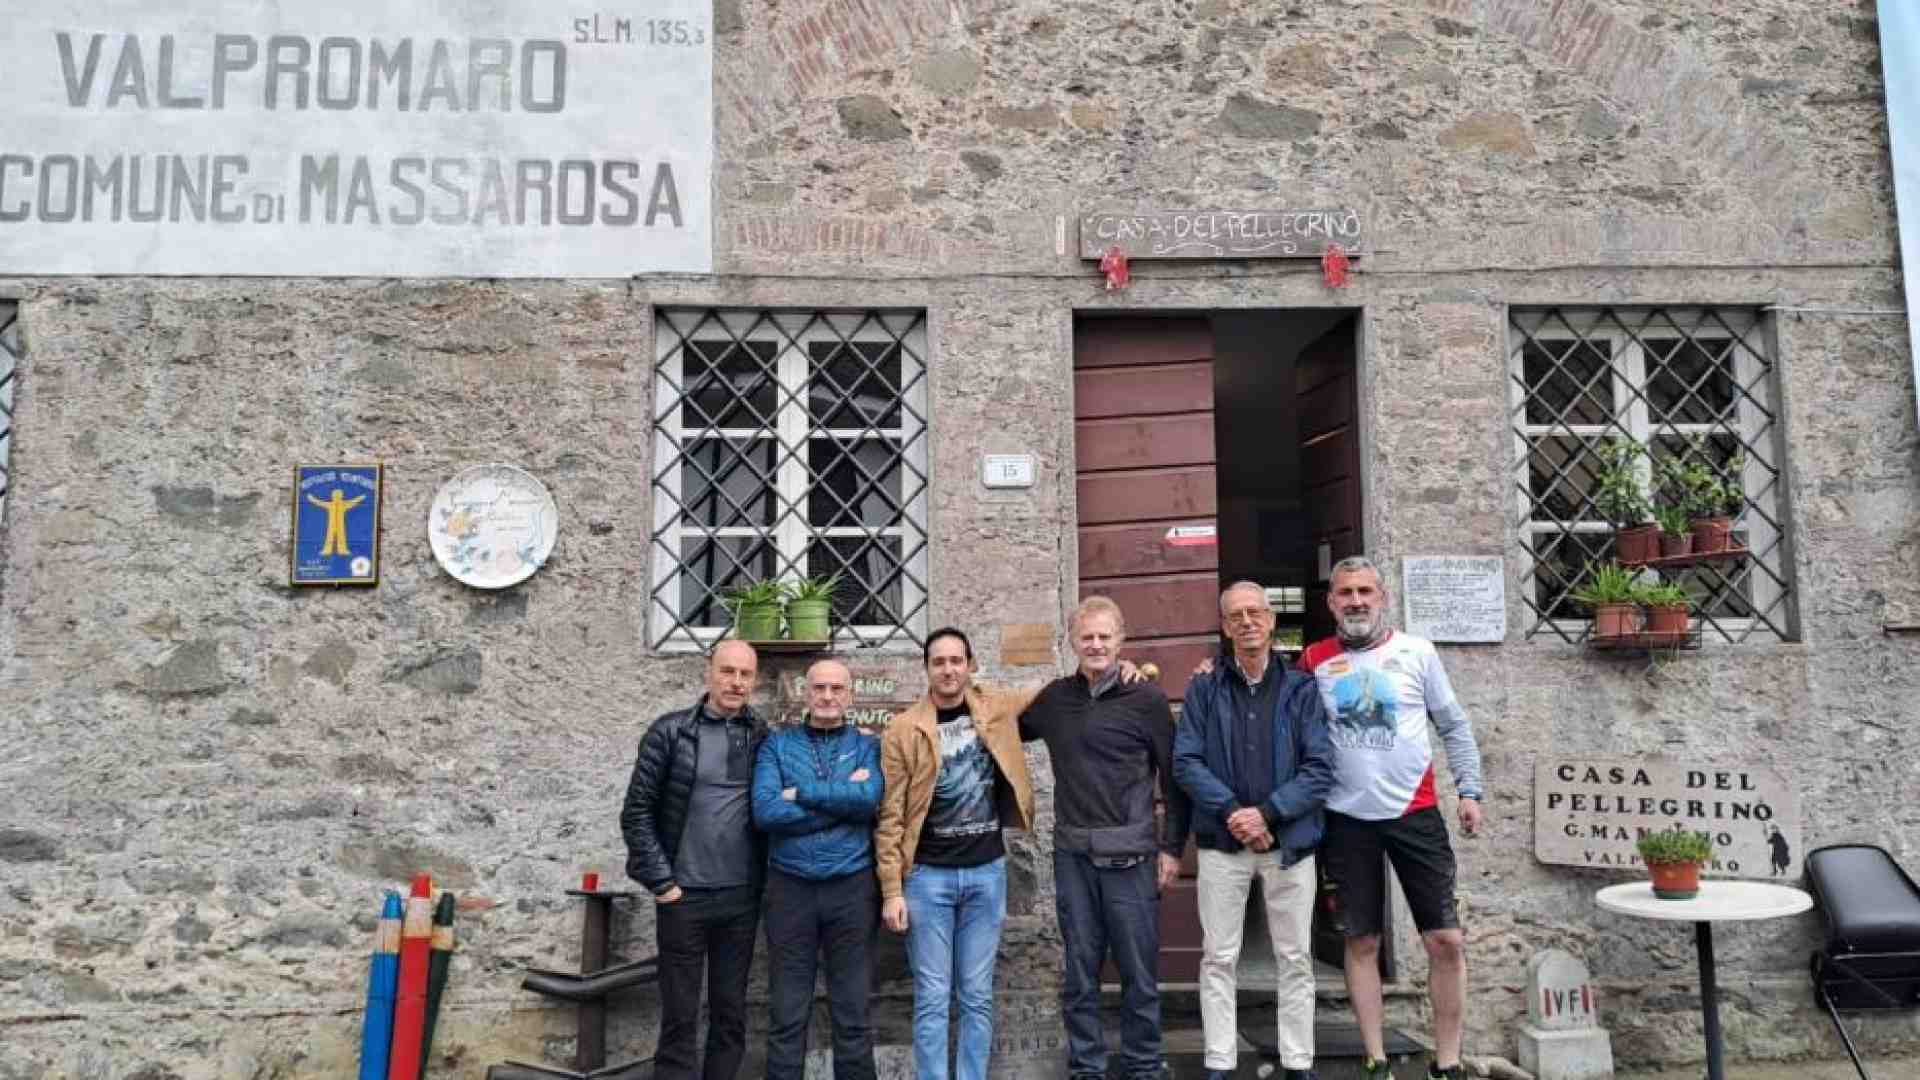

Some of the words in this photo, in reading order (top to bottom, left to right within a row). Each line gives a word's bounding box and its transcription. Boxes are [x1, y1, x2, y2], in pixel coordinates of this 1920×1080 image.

[56, 32, 567, 113] VALPROMARO
[0, 153, 250, 224] COMUNE
[252, 193, 285, 224] DI
[299, 154, 684, 228] MASSAROSA
[1097, 217, 1167, 240] CASA
[1175, 214, 1219, 239] DEL
[1003, 463, 1018, 479] 15
[1557, 764, 1652, 786] CASA
[1687, 770, 1756, 791] DEL
[1548, 793, 1774, 822] PELLEGRINO
